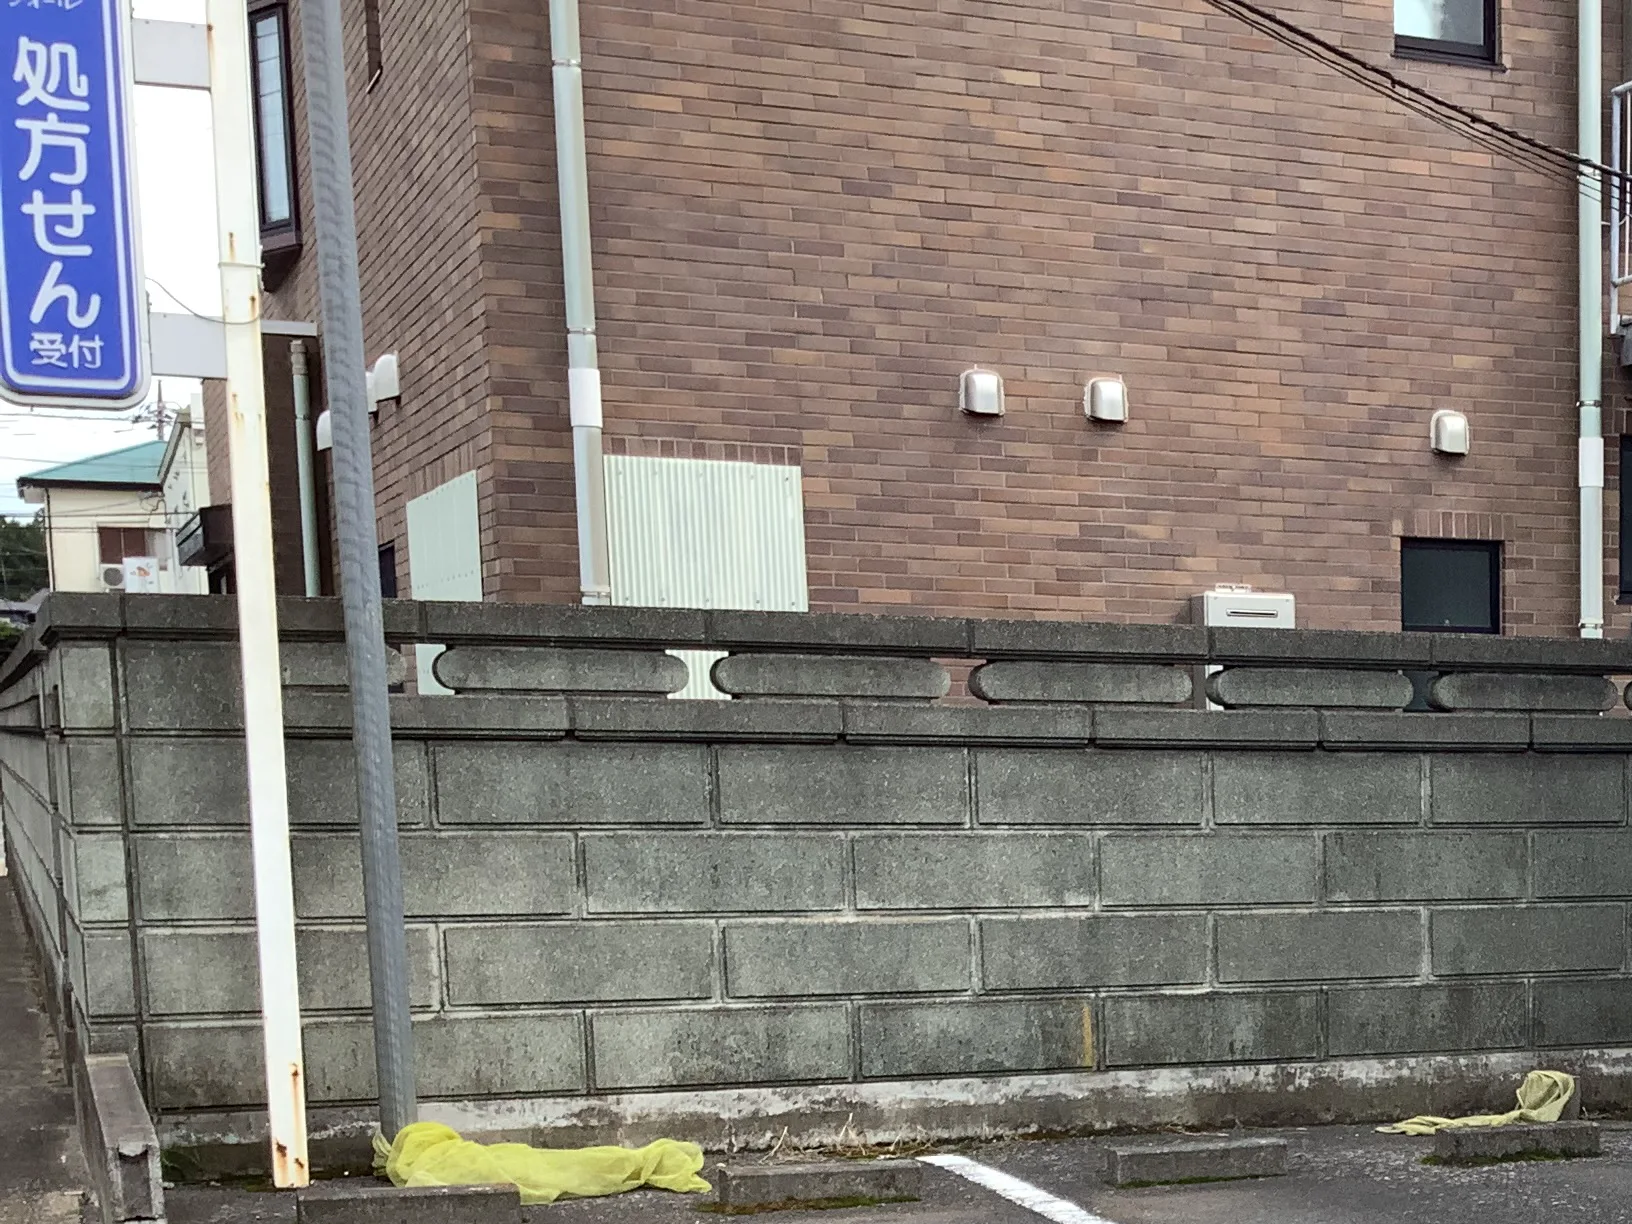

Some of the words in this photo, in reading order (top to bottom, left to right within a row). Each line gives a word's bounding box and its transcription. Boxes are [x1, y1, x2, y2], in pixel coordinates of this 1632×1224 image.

[13, 36, 100, 329] 処方せん
[29, 332, 104, 369] 受付
